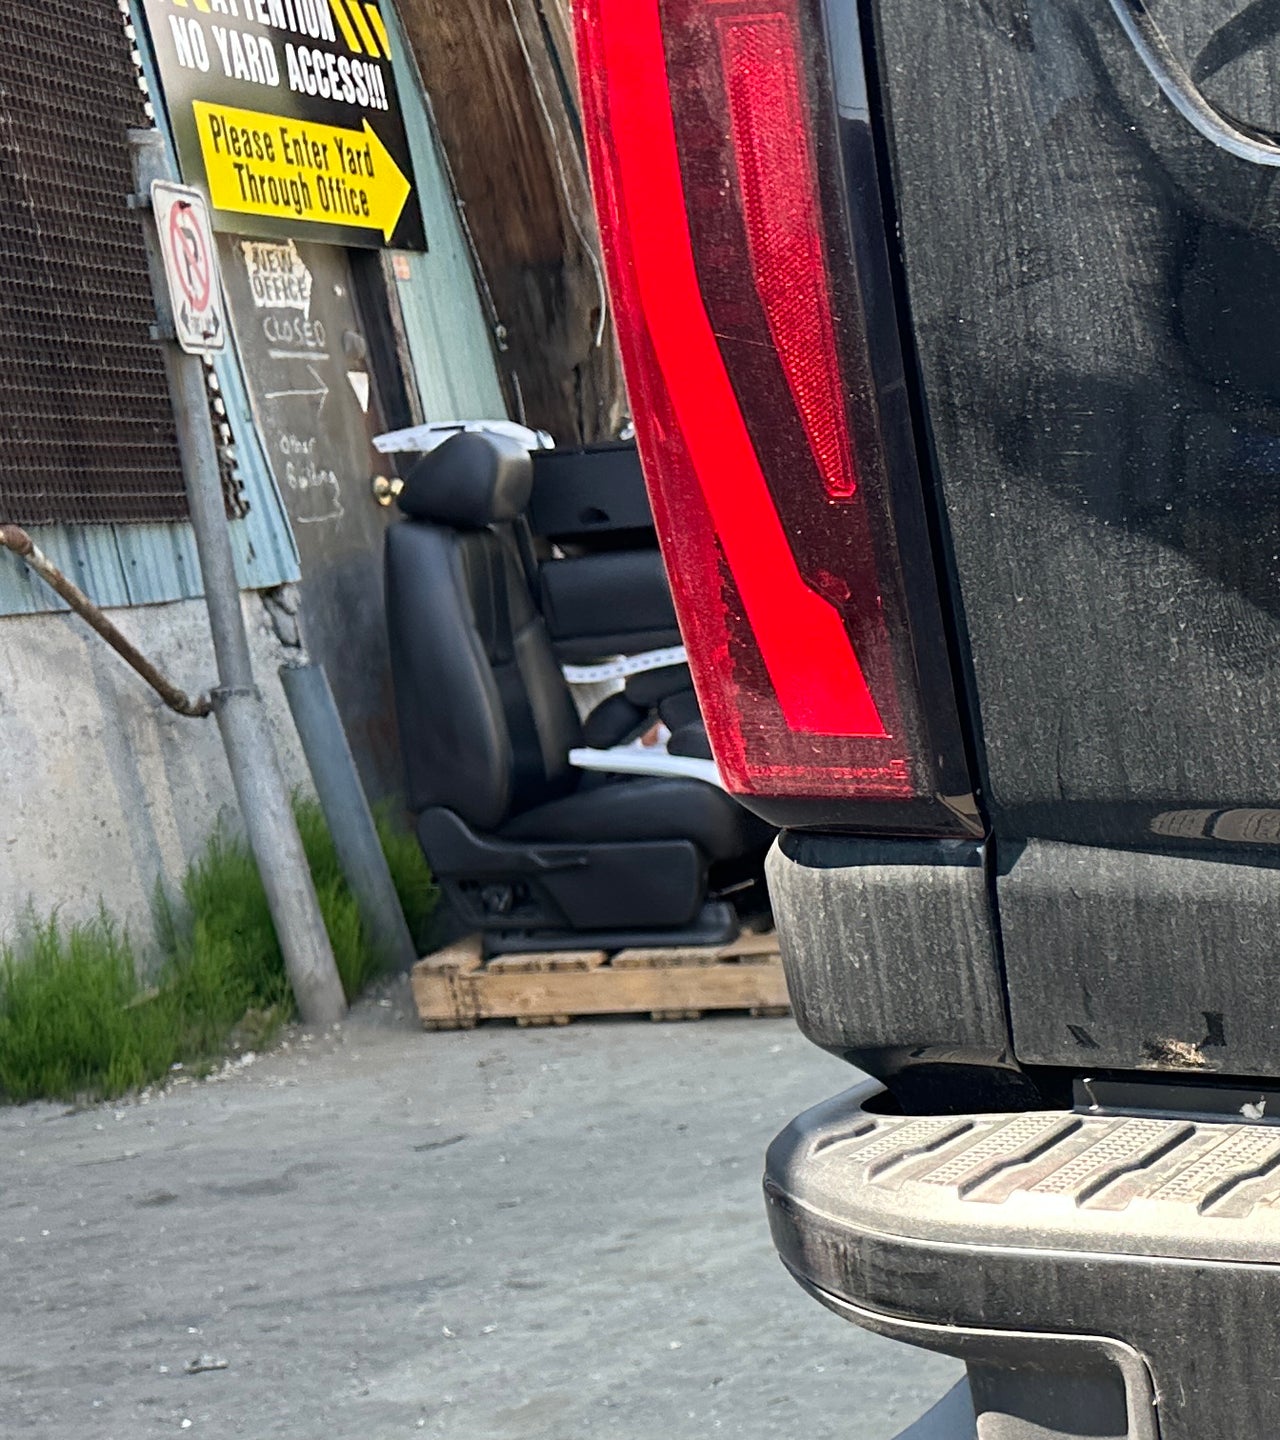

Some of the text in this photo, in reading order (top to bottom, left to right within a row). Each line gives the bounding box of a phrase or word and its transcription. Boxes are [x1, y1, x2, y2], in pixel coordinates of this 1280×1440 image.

[168, 14, 389, 111] NO YARD ACCESS!!!
[208, 113, 375, 179] Please Enter Yard
[233, 162, 370, 217] Through Office
[254, 275, 309, 303] OFFICE
[263, 315, 326, 347] CLOSED
